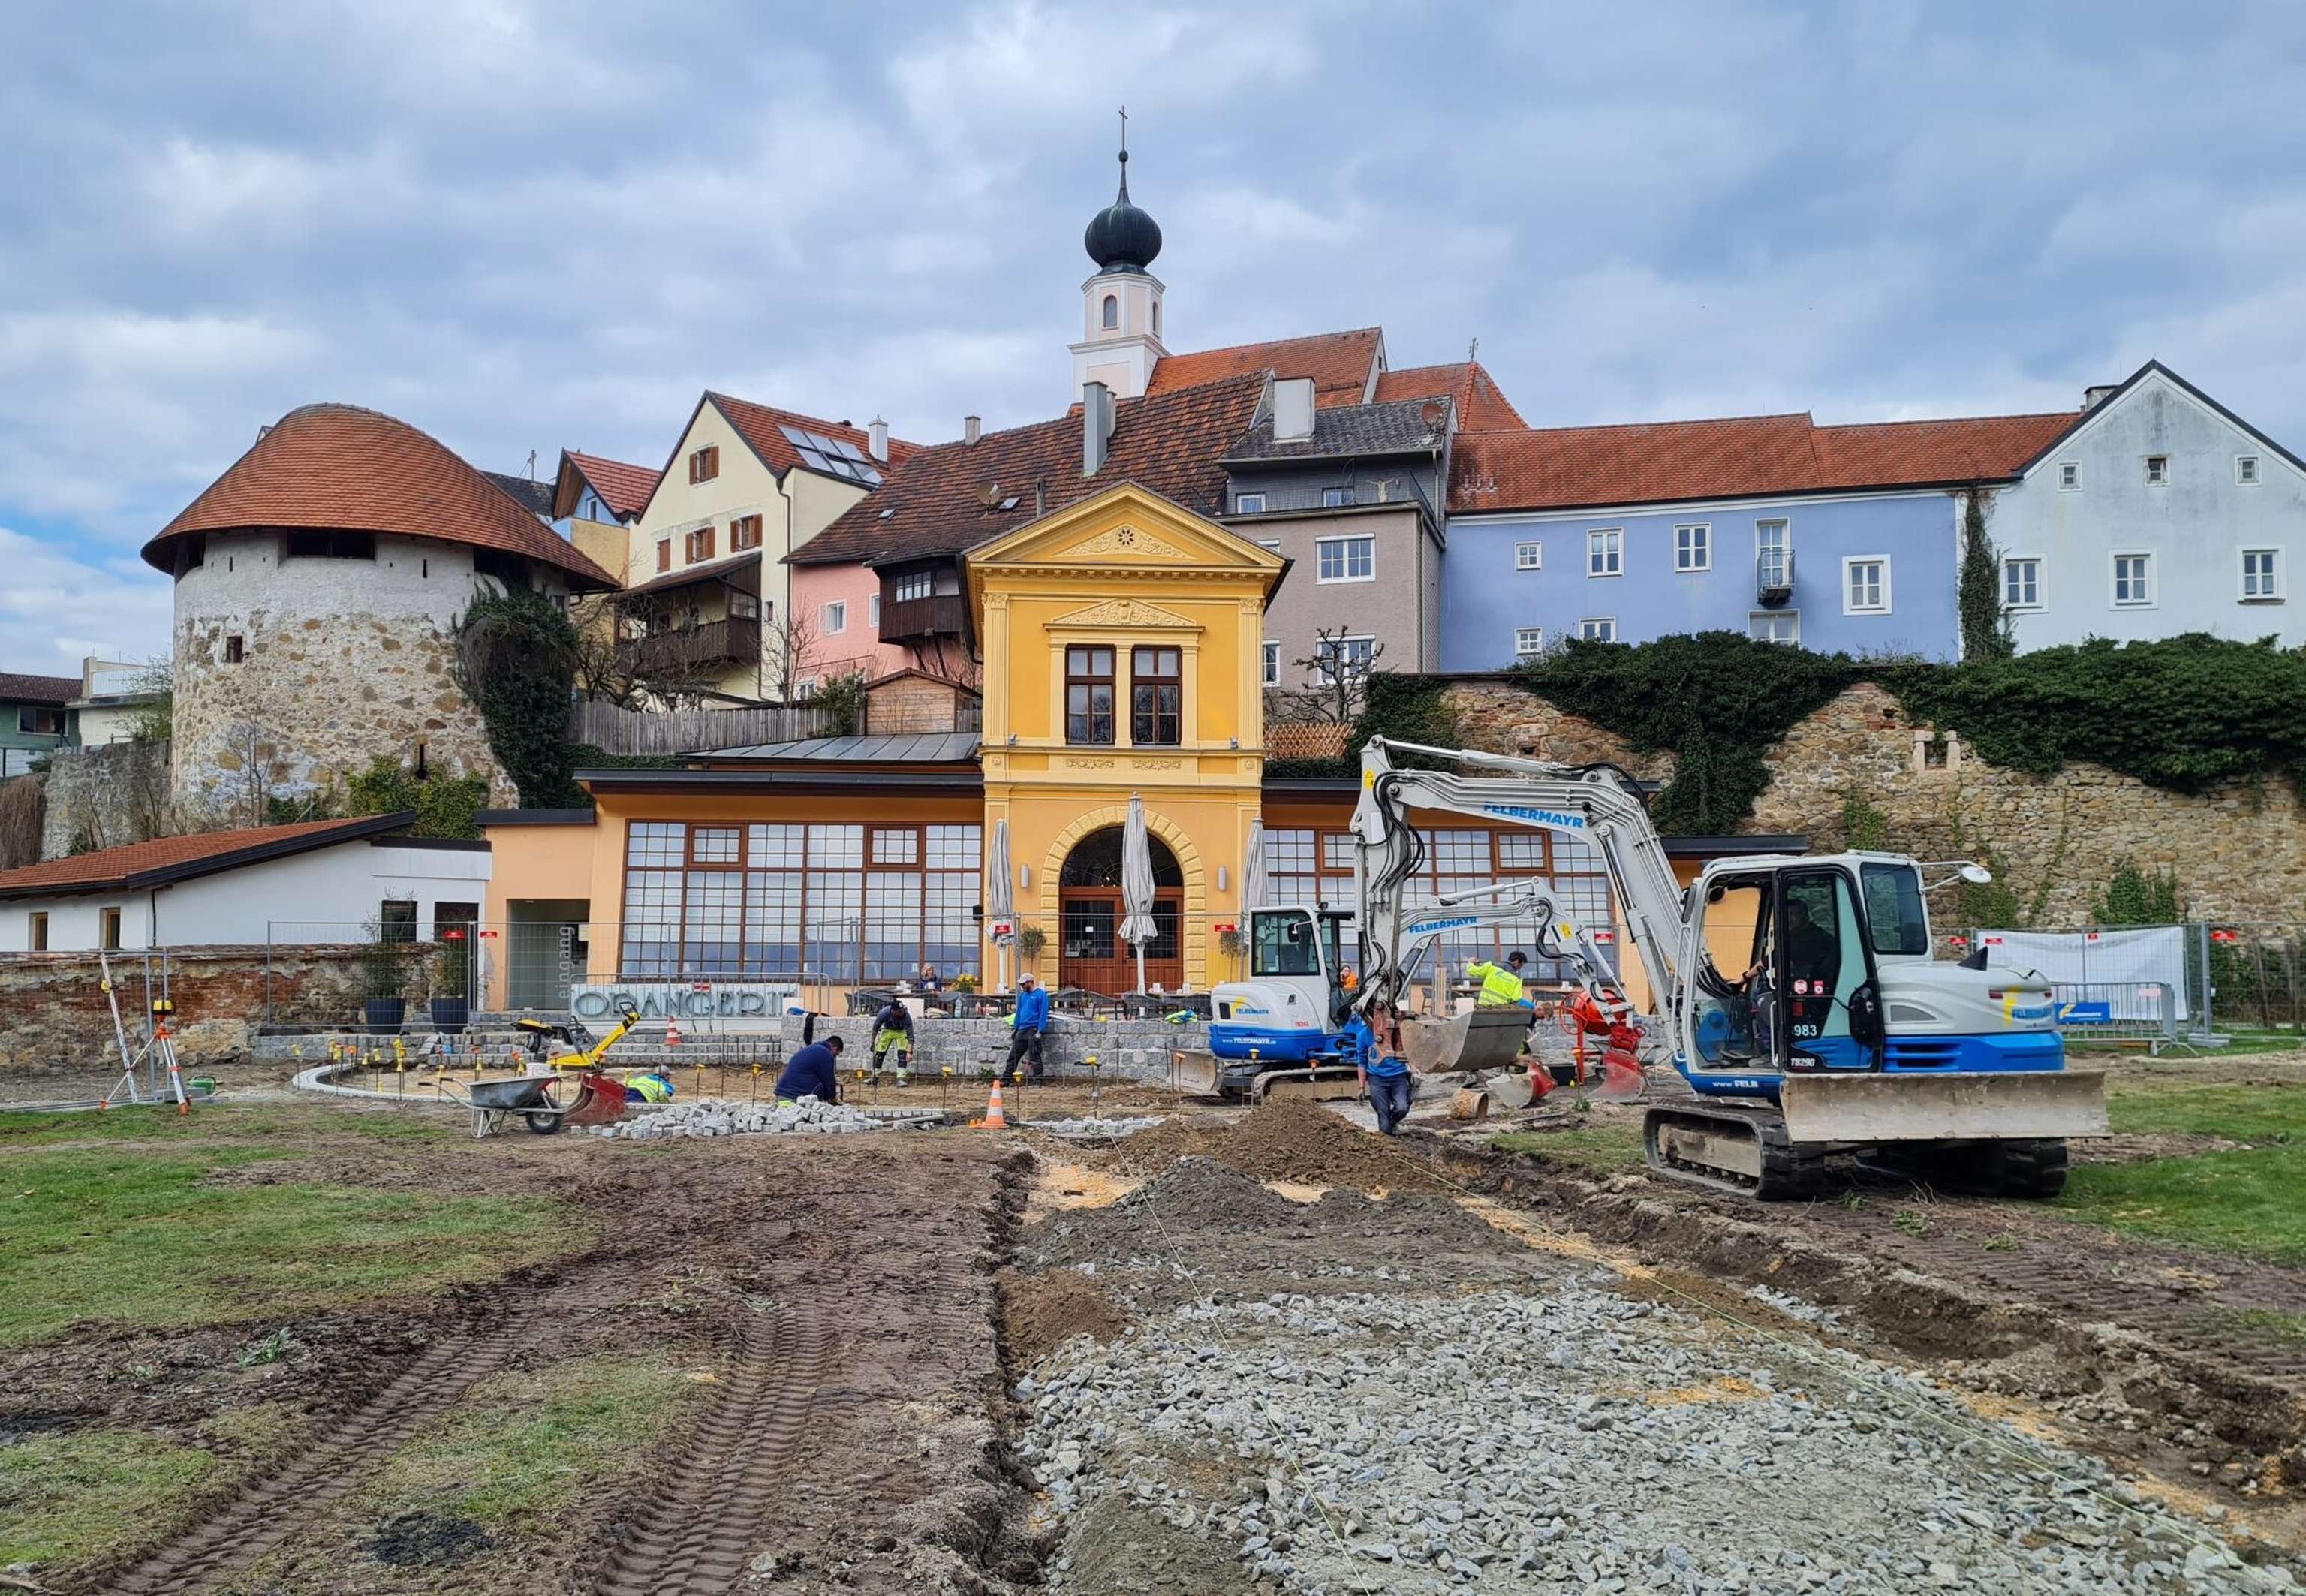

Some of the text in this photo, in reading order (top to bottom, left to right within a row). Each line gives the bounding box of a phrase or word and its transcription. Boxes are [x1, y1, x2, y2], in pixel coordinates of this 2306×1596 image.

[1483, 801, 1584, 828] FELBERMAYR
[1409, 916, 1477, 932] FELBERMAYR
[555, 926, 575, 998] eingang
[1793, 1024, 1817, 1037] 983
[1790, 1058, 1815, 1067] TB290
